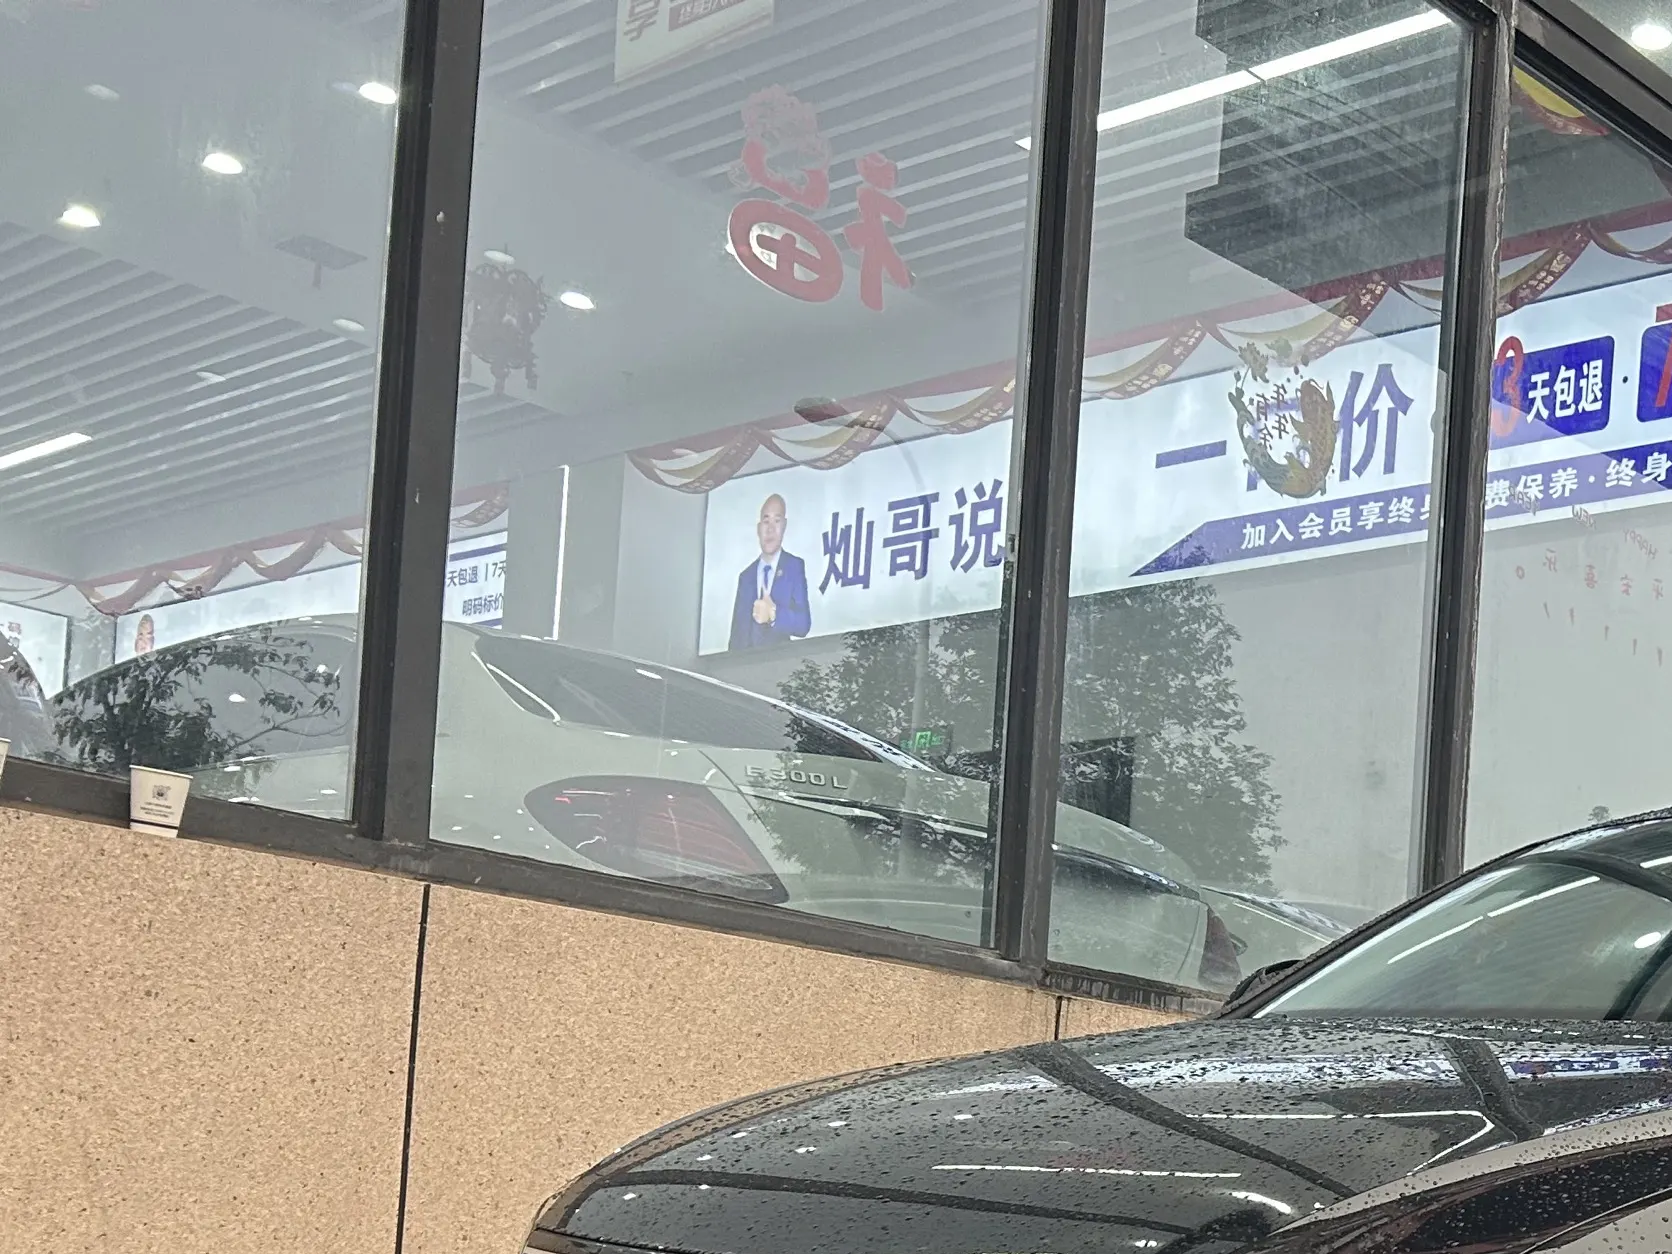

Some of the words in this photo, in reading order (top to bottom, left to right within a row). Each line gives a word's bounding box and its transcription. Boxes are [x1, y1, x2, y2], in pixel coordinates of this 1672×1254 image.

[1155, 363, 1415, 492] 一价
[818, 478, 1006, 595] 灿哥说
